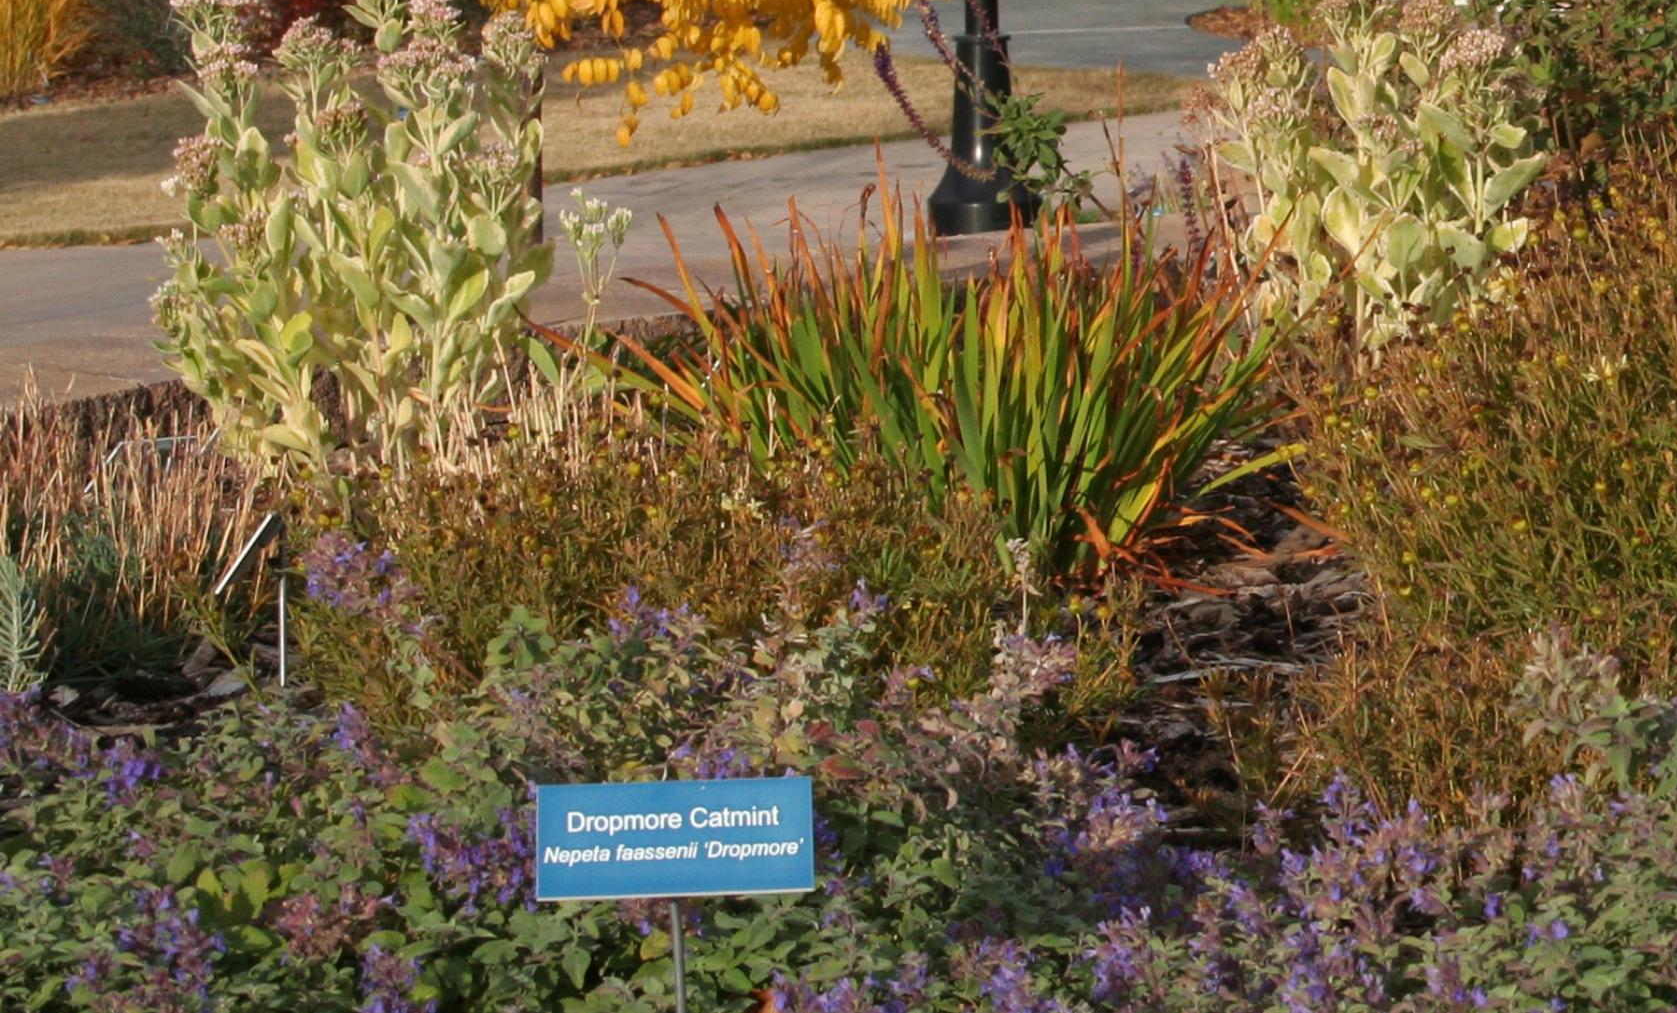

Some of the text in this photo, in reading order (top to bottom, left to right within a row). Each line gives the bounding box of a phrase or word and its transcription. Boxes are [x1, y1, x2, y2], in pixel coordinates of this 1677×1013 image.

[567, 806, 779, 836] Dropmore Catmint
[543, 846, 611, 867] Nepeta
[616, 842, 698, 861] faassenii
